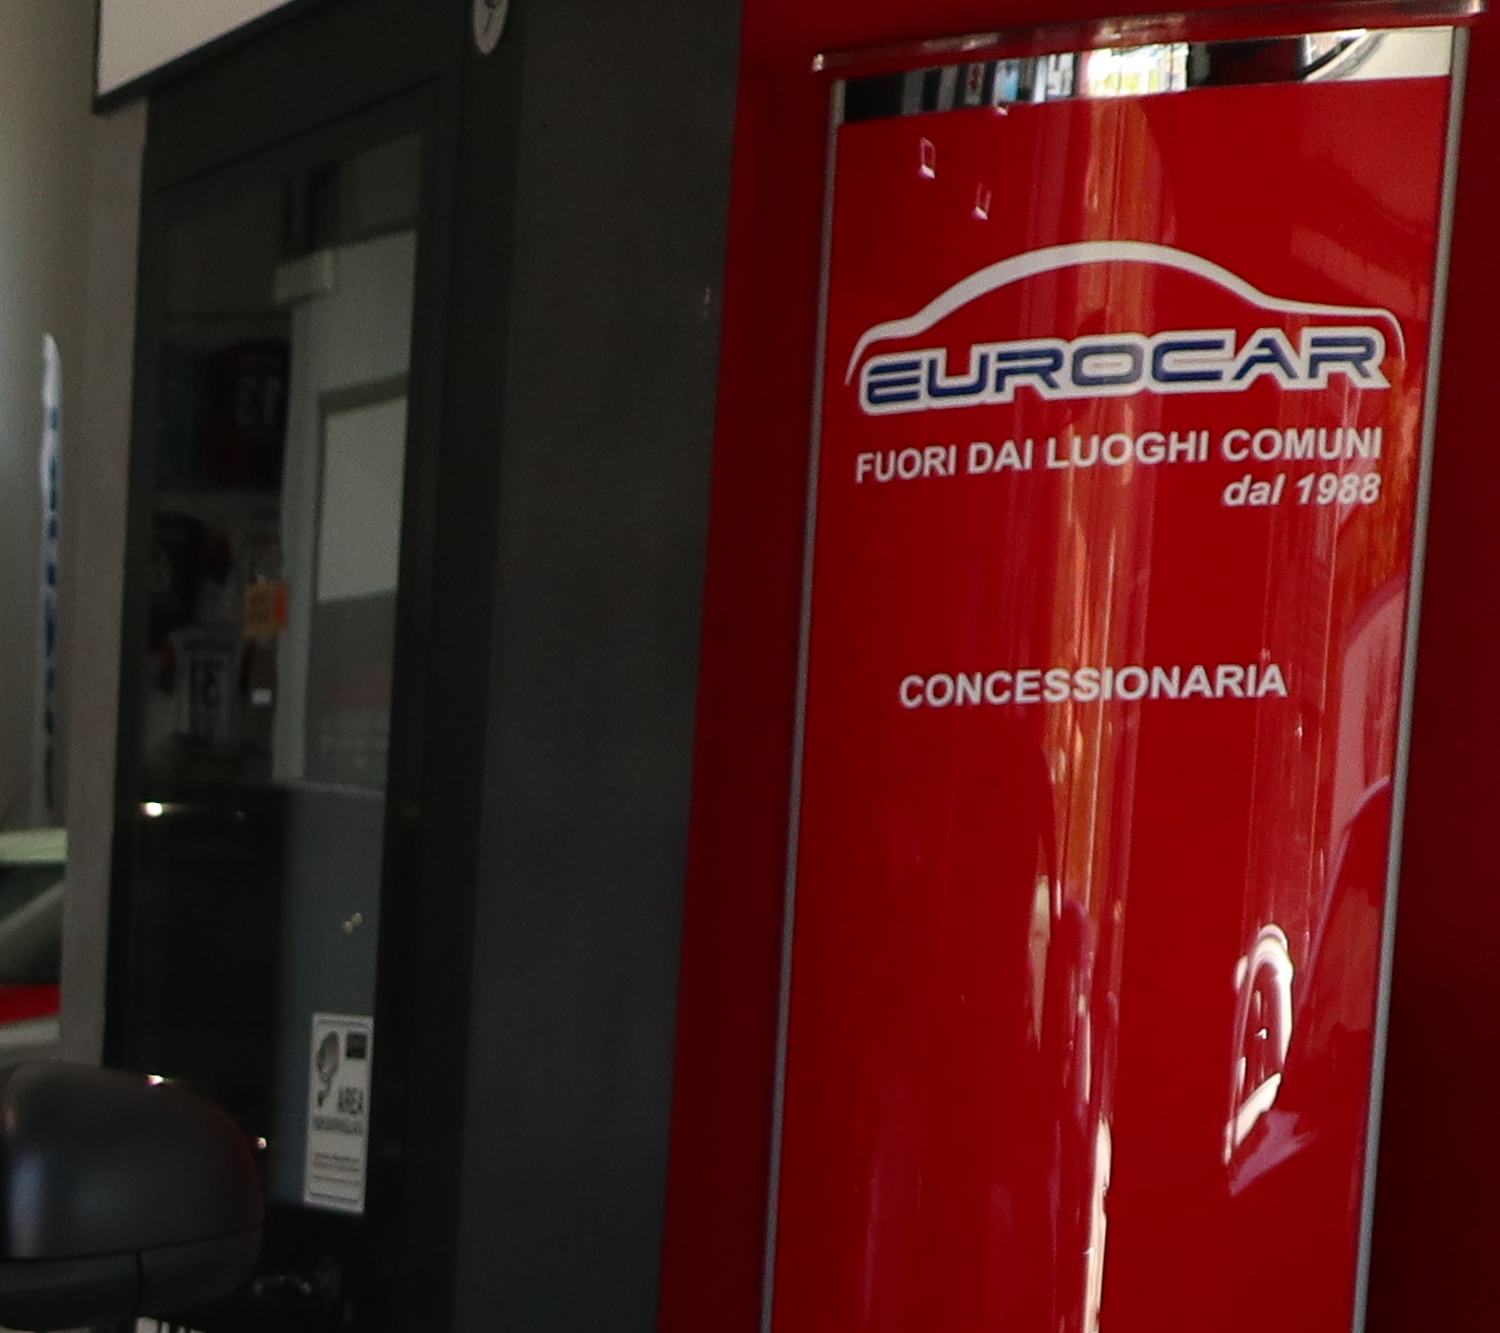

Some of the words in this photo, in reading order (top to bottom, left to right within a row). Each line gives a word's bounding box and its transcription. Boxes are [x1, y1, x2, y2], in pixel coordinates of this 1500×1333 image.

[863, 328, 1390, 414] EUROCAR
[856, 445, 957, 484] FUORI
[968, 441, 1033, 474] DAI
[1047, 431, 1209, 470] LUOGHI
[1220, 427, 1382, 464] COMUNI
[1222, 474, 1284, 507] dal
[1295, 472, 1381, 505] 1988
[898, 665, 1288, 709] CONCESSIONARIA
